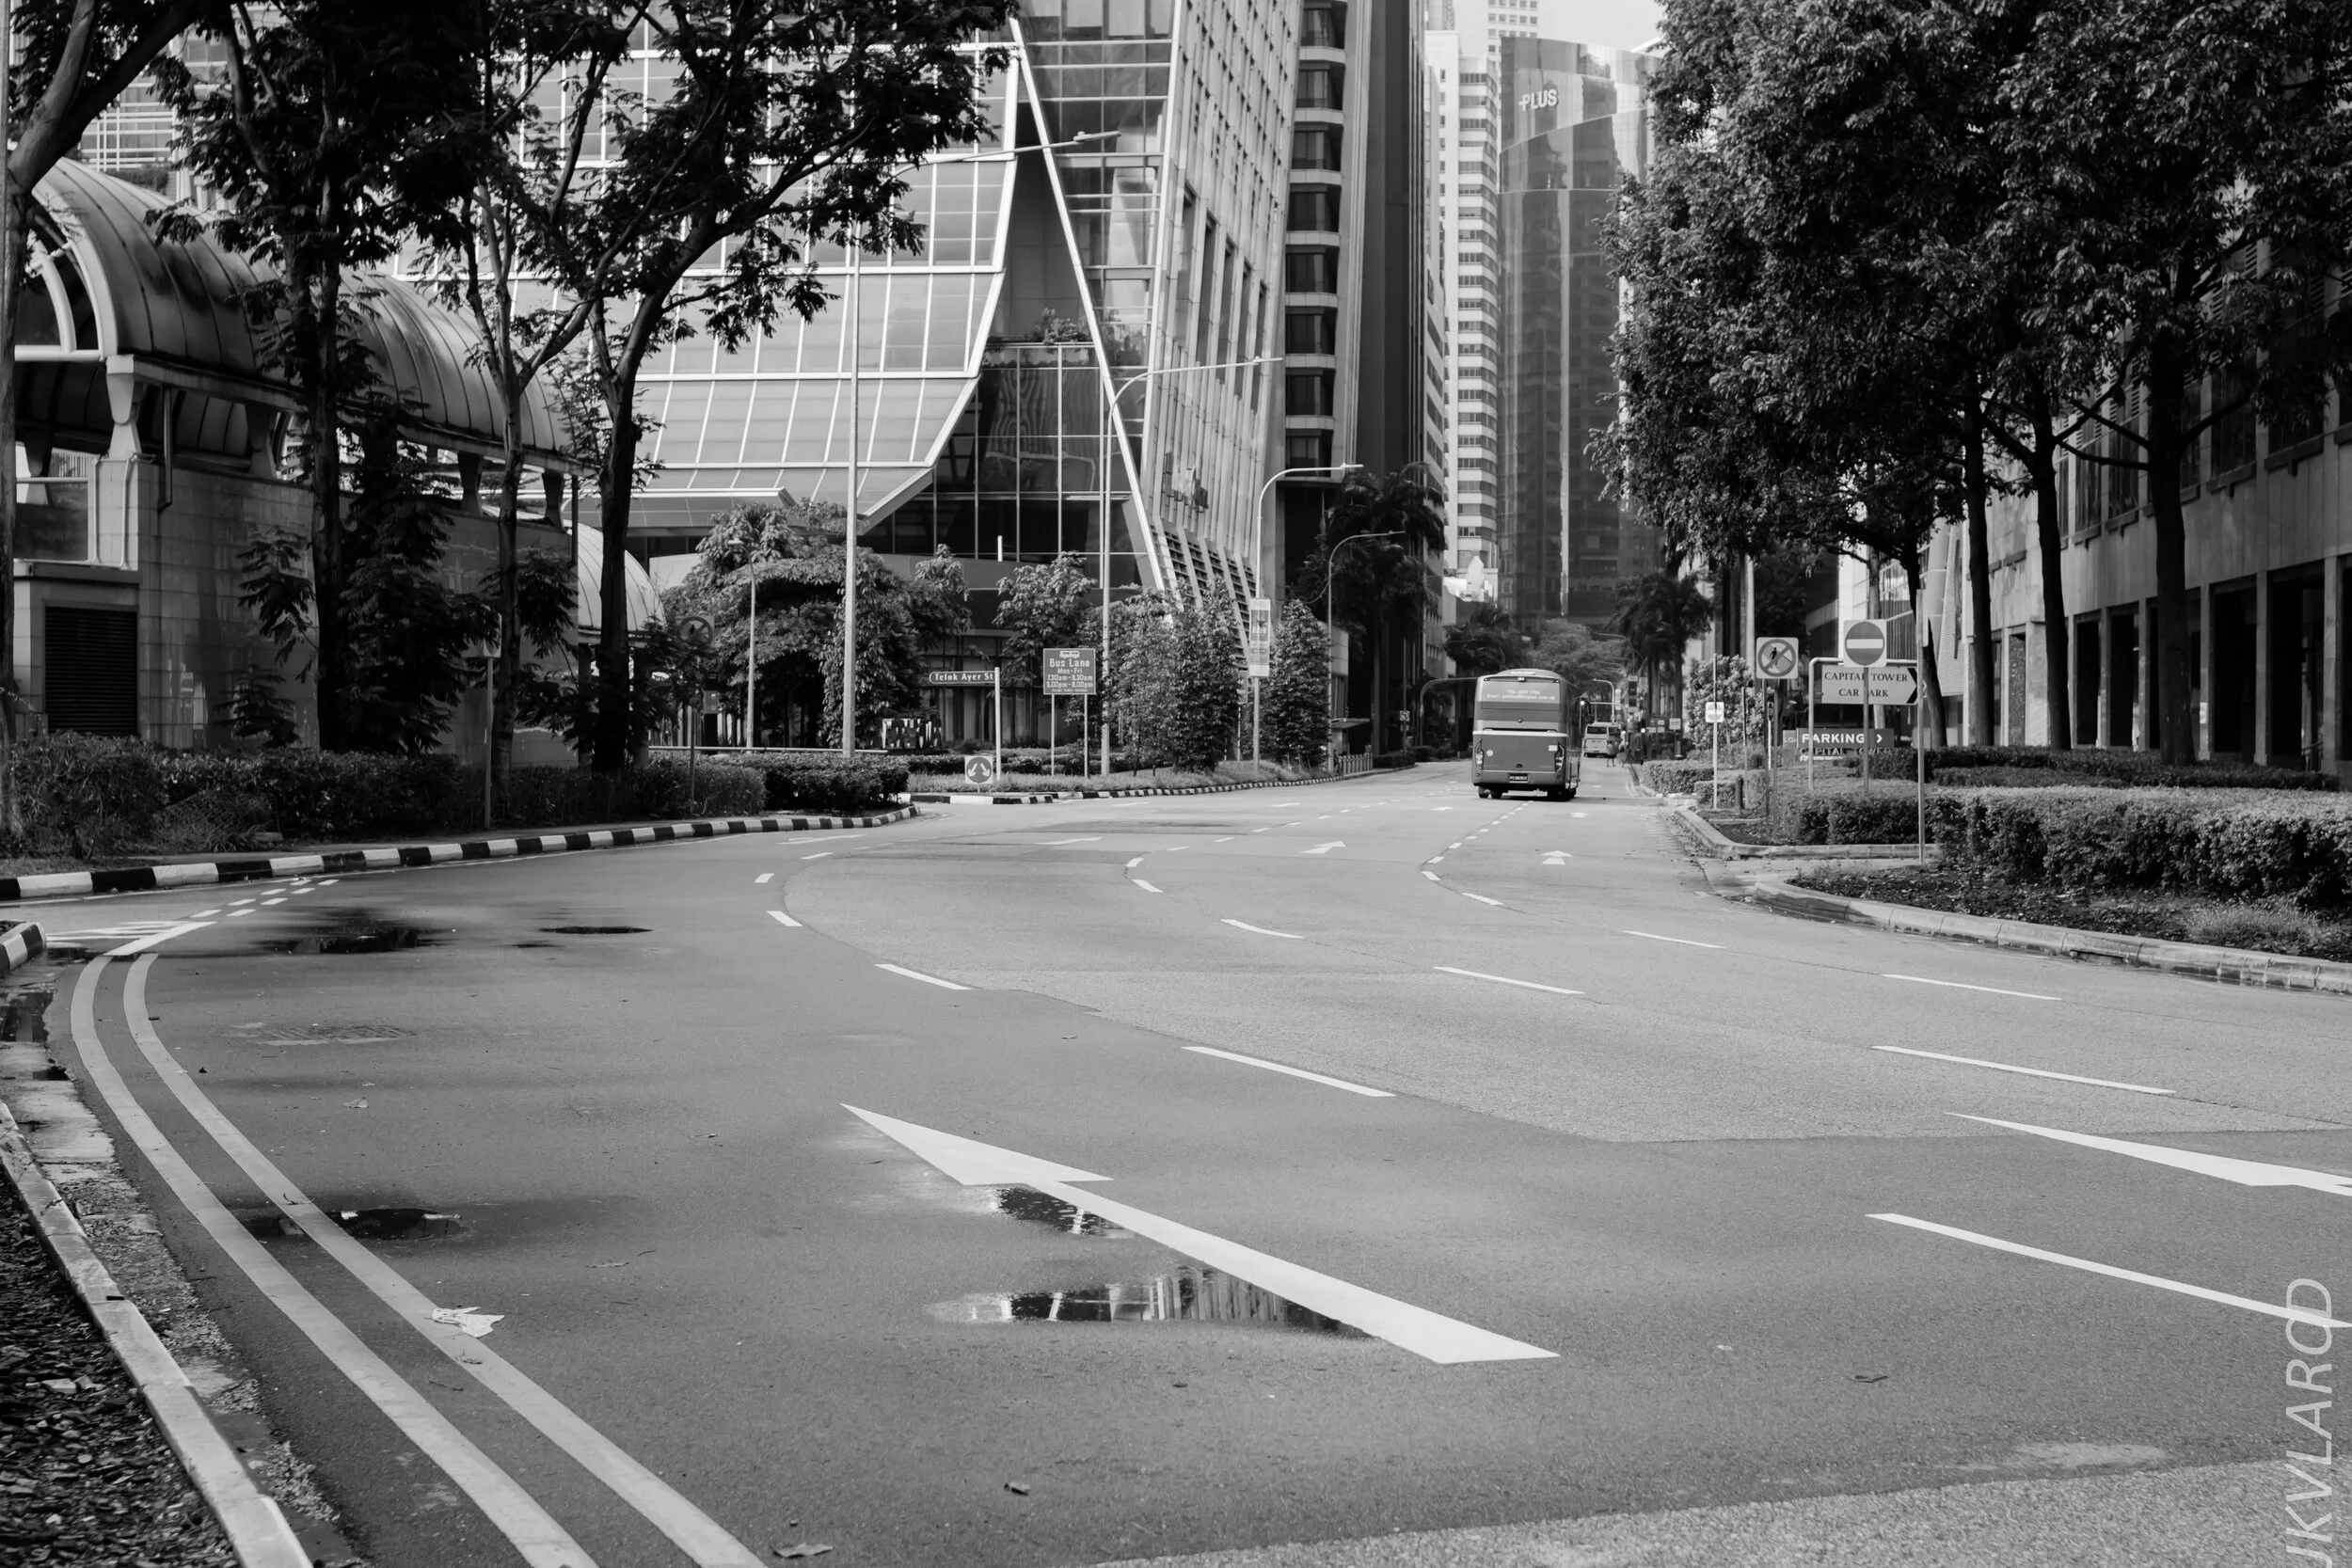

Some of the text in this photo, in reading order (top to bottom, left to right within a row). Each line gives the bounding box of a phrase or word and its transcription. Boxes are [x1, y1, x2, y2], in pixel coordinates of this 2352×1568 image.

[1518, 89, 1558, 111] PLUS
[1050, 658, 1090, 667] Bus Lane
[961, 673, 981, 682] Ayer
[1871, 673, 1908, 682] TOWER
[1838, 689, 1889, 698] CAR ARK
[1802, 733, 1866, 744] PARKING
[1799, 747, 1845, 755] CPITAL
